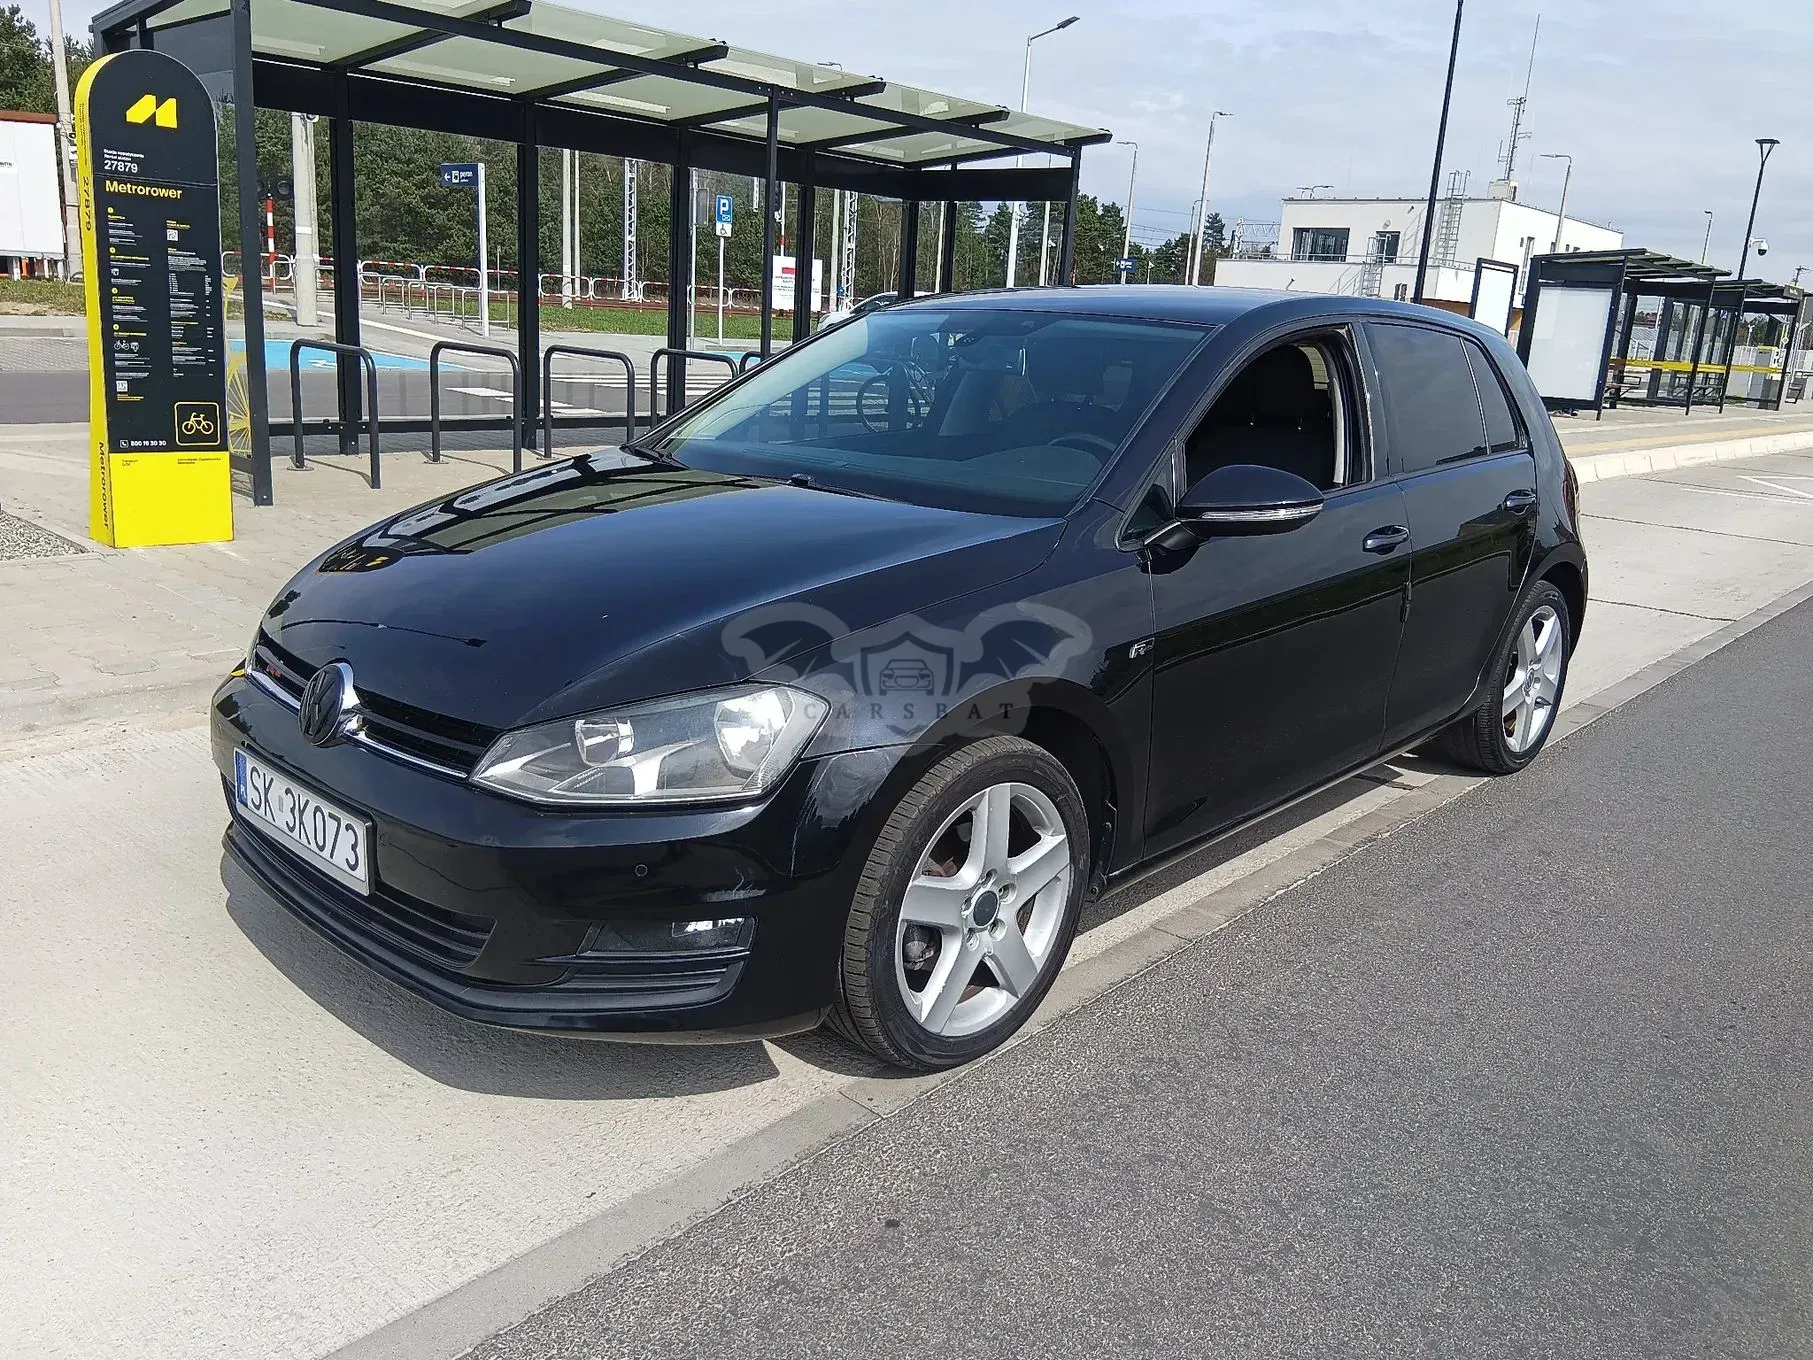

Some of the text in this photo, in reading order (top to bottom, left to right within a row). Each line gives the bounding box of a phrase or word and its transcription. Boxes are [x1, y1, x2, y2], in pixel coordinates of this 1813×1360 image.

[104, 160, 138, 173] 27879
[83, 176, 92, 231] 27879
[105, 180, 182, 199] Metrorower
[720, 199, 729, 215] P
[99, 441, 109, 529] Metrorower
[250, 766, 359, 872] SK 3K073
